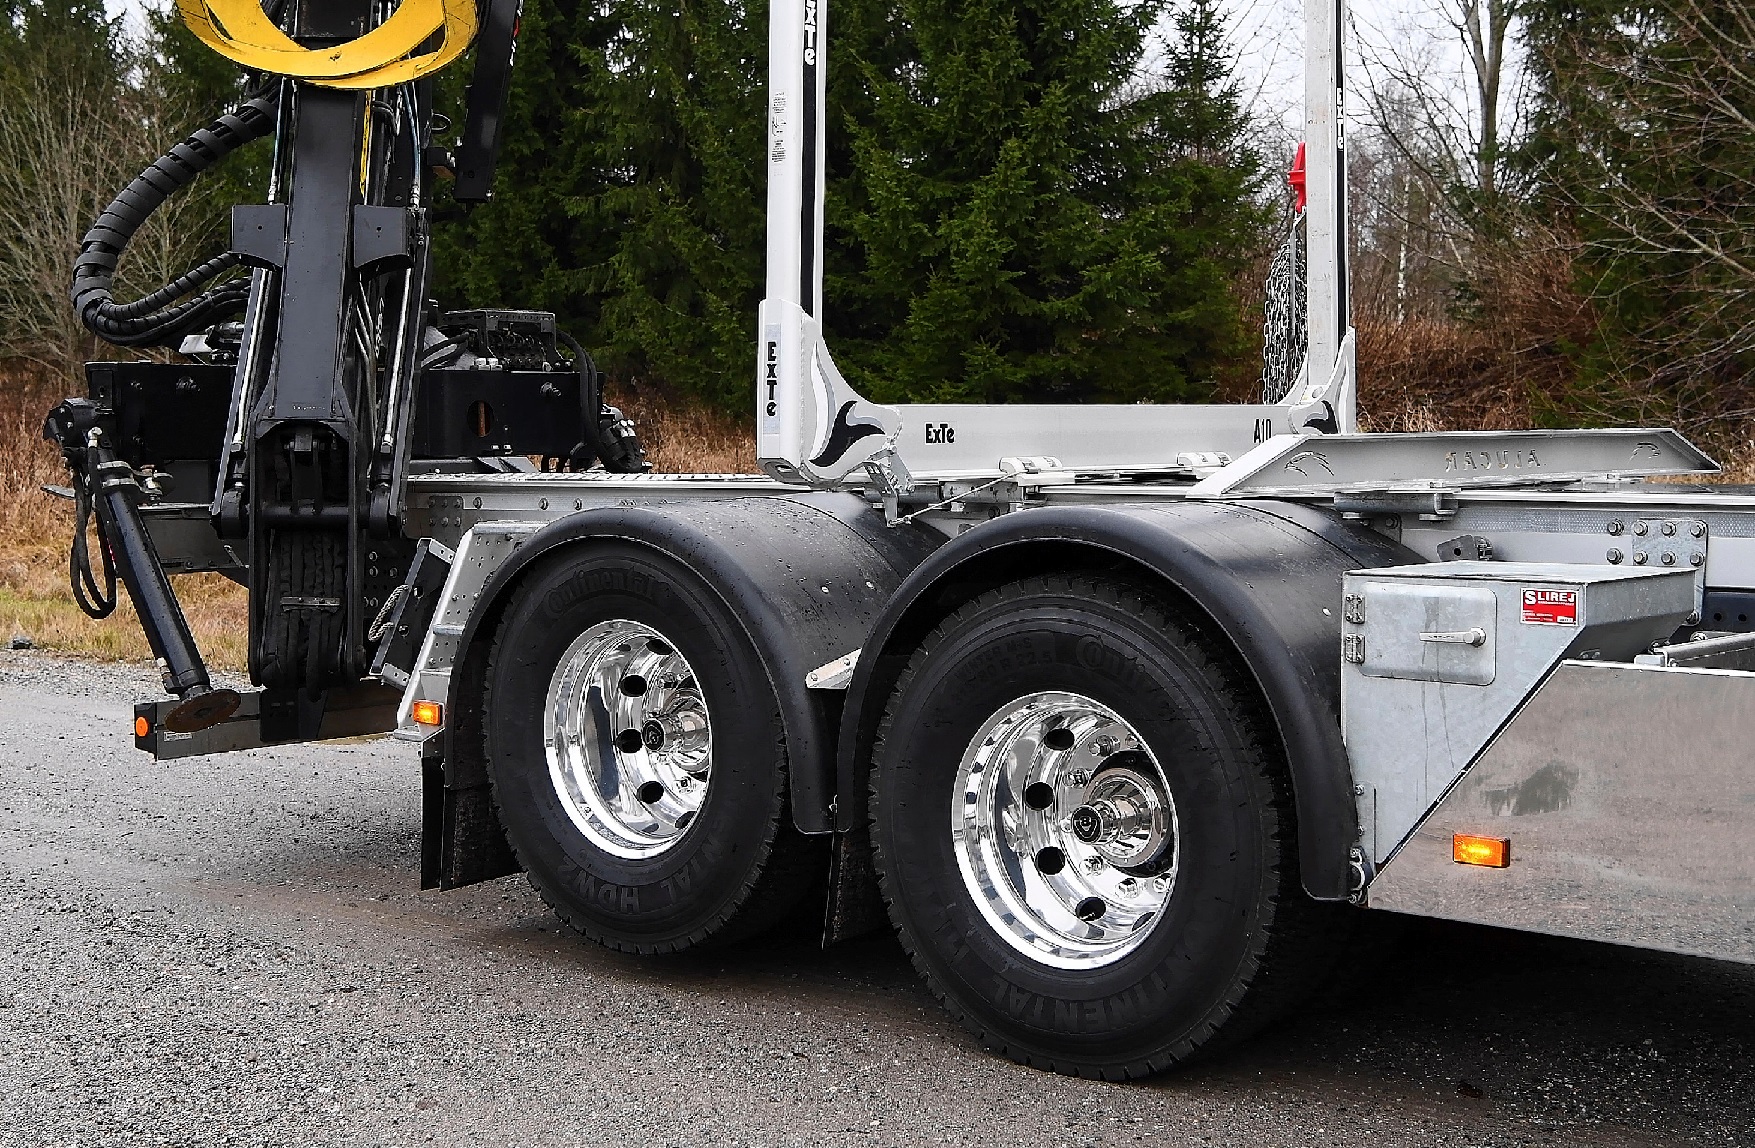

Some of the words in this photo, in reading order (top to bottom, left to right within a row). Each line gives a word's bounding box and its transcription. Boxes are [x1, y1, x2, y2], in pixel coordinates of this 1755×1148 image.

[925, 423, 955, 444] ExTe
[1253, 418, 1272, 444] A10
[543, 566, 654, 620] Continental
[1524, 590, 1575, 605] SLIREJ
